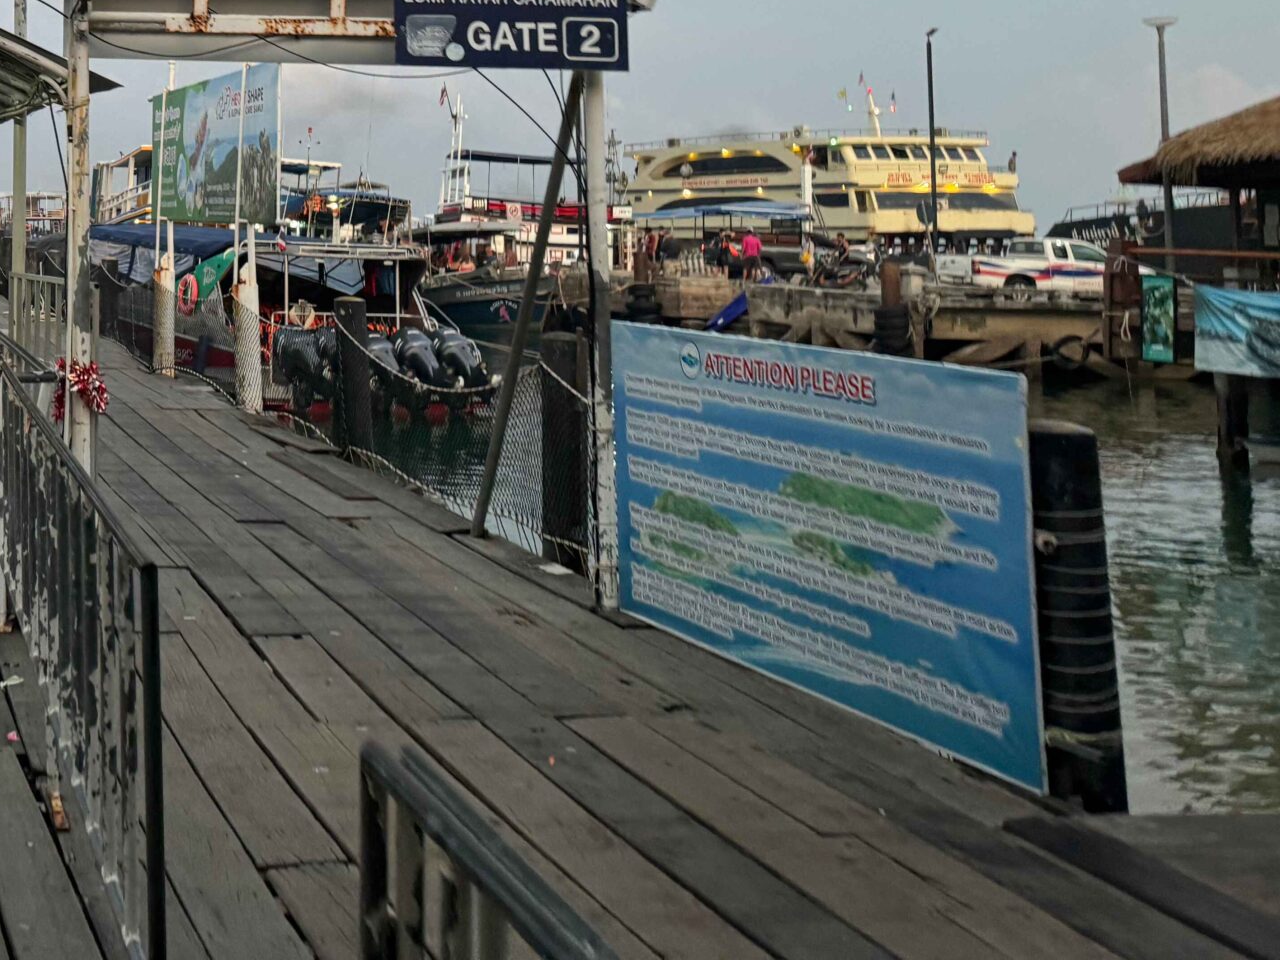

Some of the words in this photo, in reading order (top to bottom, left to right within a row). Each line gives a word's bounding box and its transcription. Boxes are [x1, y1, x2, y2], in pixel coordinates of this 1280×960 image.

[466, 21, 559, 52] GATE
[579, 24, 602, 54] 2
[703, 352, 796, 392] ATTENTION
[799, 368, 876, 405] PLEASE
